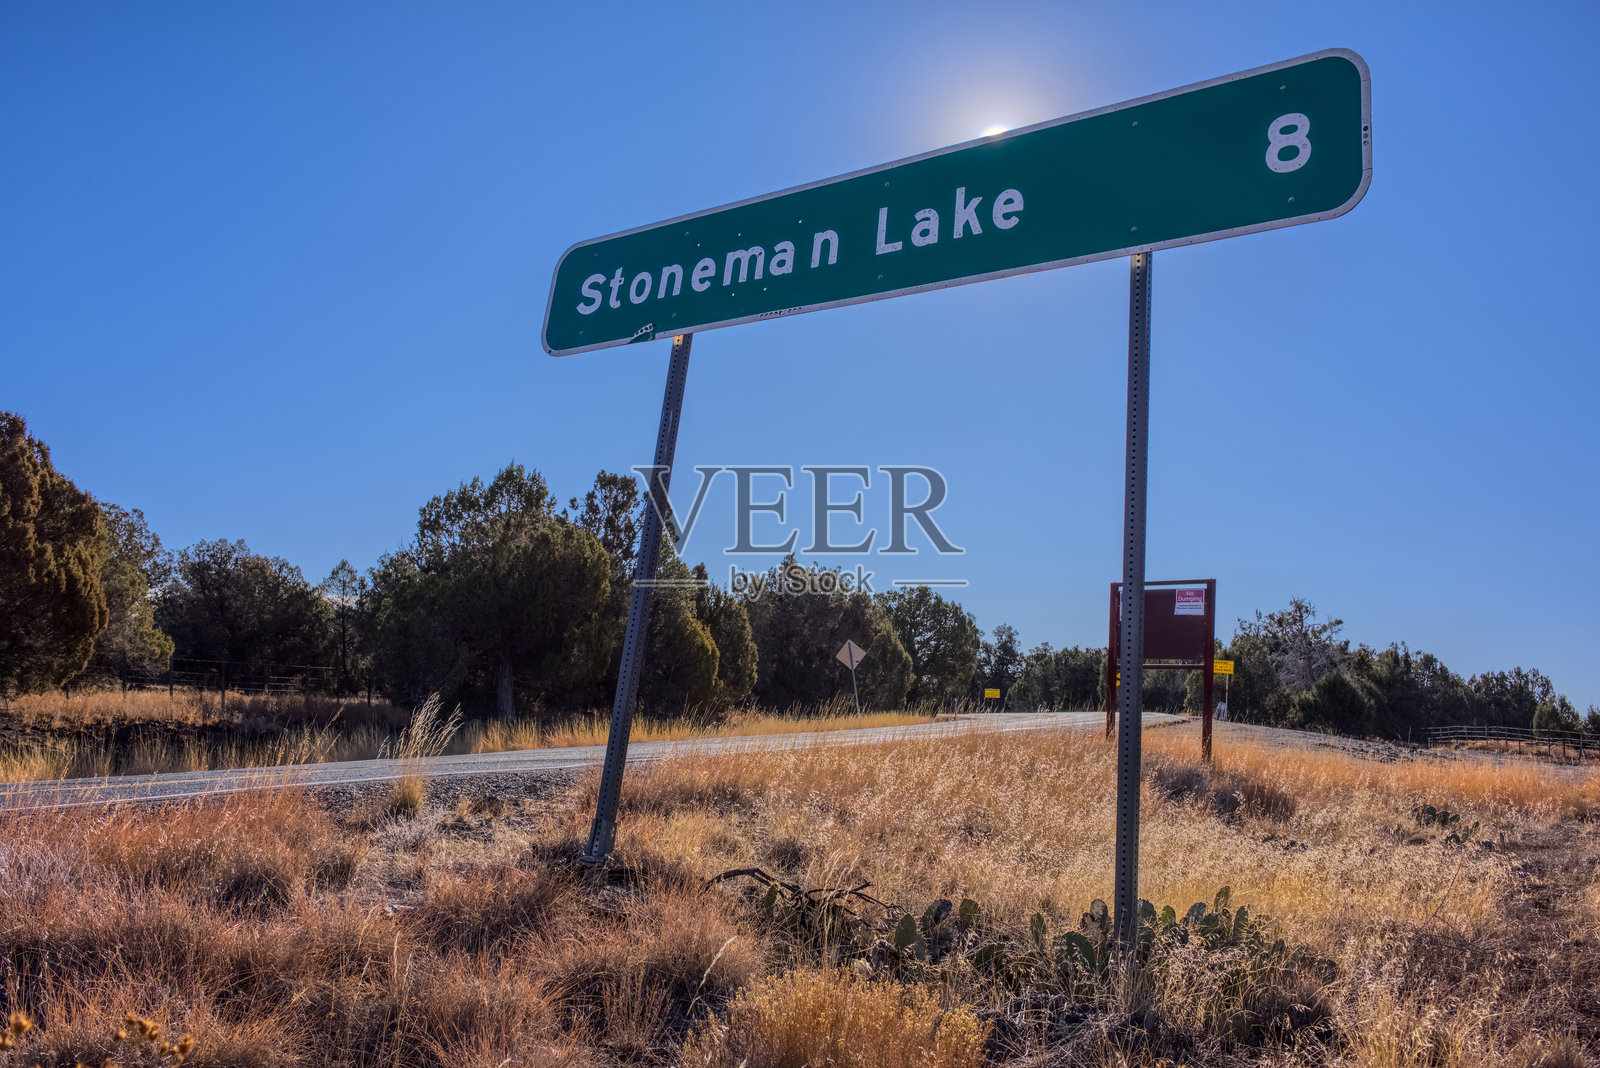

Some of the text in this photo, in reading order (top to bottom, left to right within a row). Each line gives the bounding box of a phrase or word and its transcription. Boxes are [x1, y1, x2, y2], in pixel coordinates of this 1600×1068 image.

[576, 112, 1312, 315] Stoneman Lake 8
